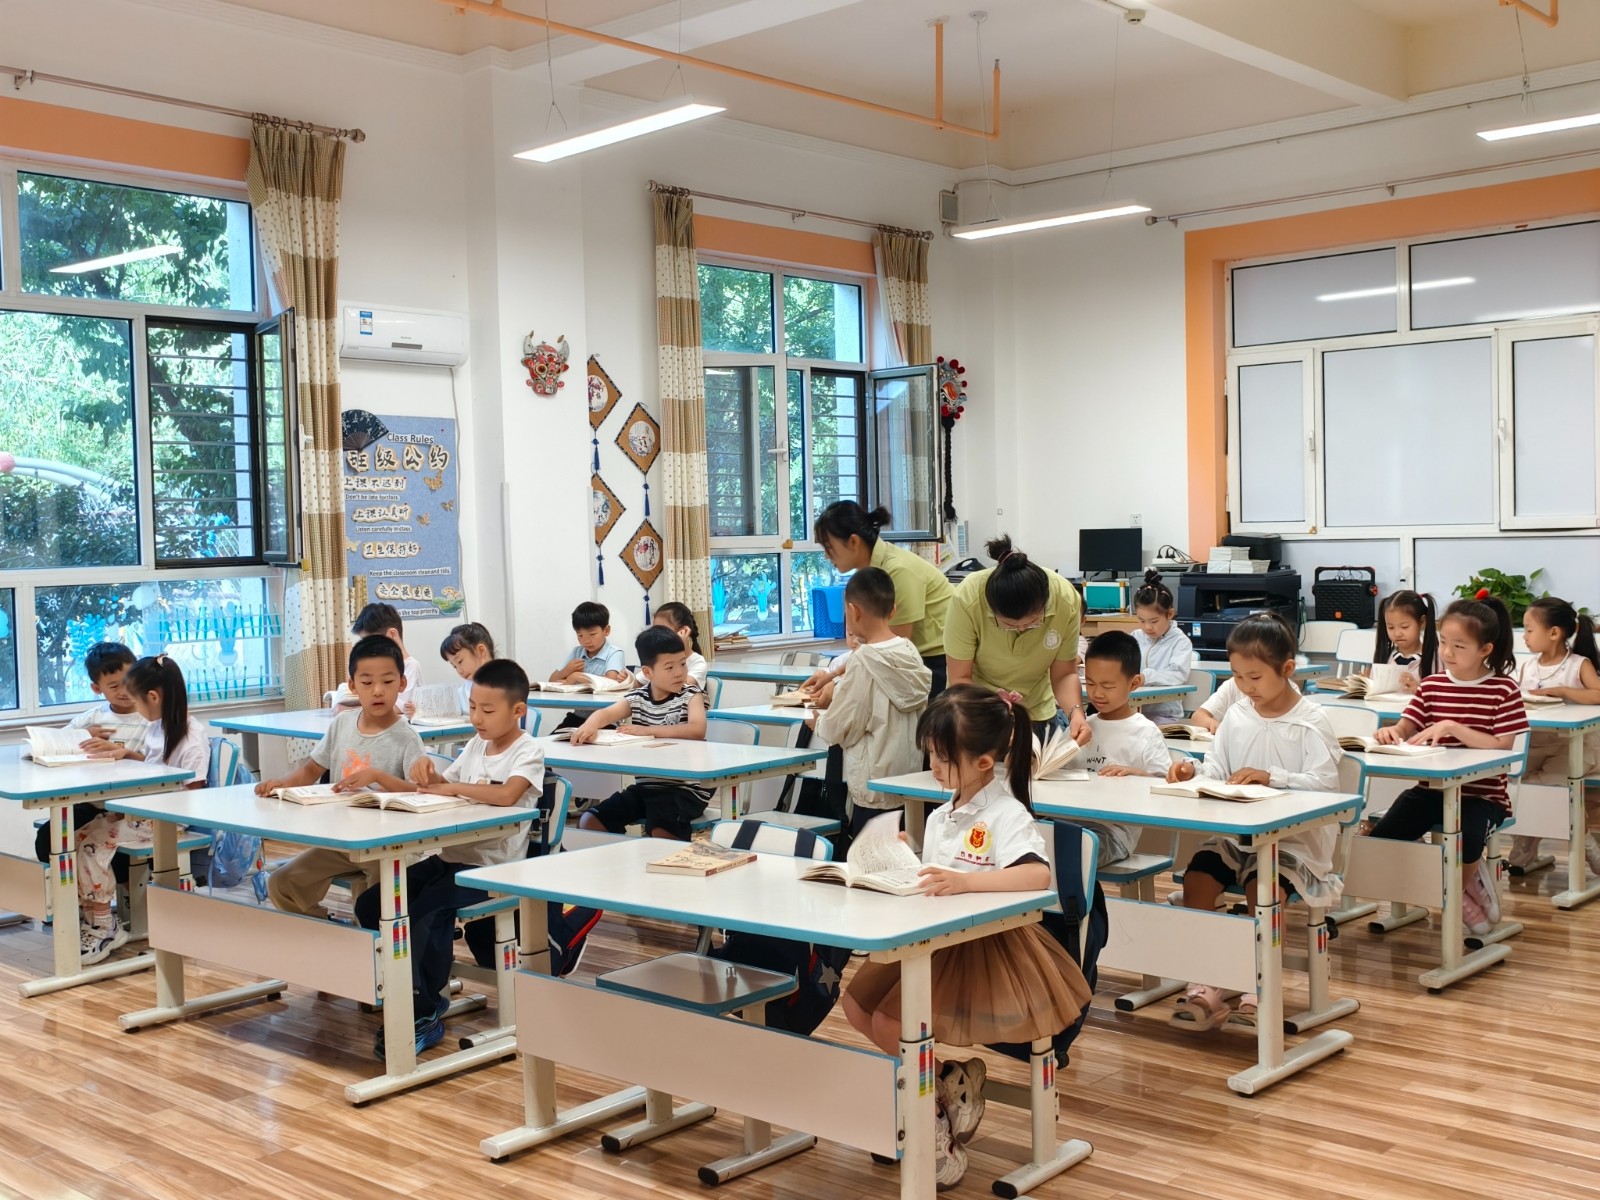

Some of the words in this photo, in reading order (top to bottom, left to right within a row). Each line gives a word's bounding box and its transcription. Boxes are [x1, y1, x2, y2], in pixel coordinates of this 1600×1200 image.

[387, 433, 408, 442] Class
[410, 434, 434, 444] Rules
[349, 445, 449, 469] 班级公约
[344, 477, 405, 488] 上课不迟到
[355, 506, 409, 519] 上课认真听
[366, 543, 418, 555] 卫生保持好
[379, 585, 432, 598] 安全最重要
[1086, 756, 1107, 764] WANT
